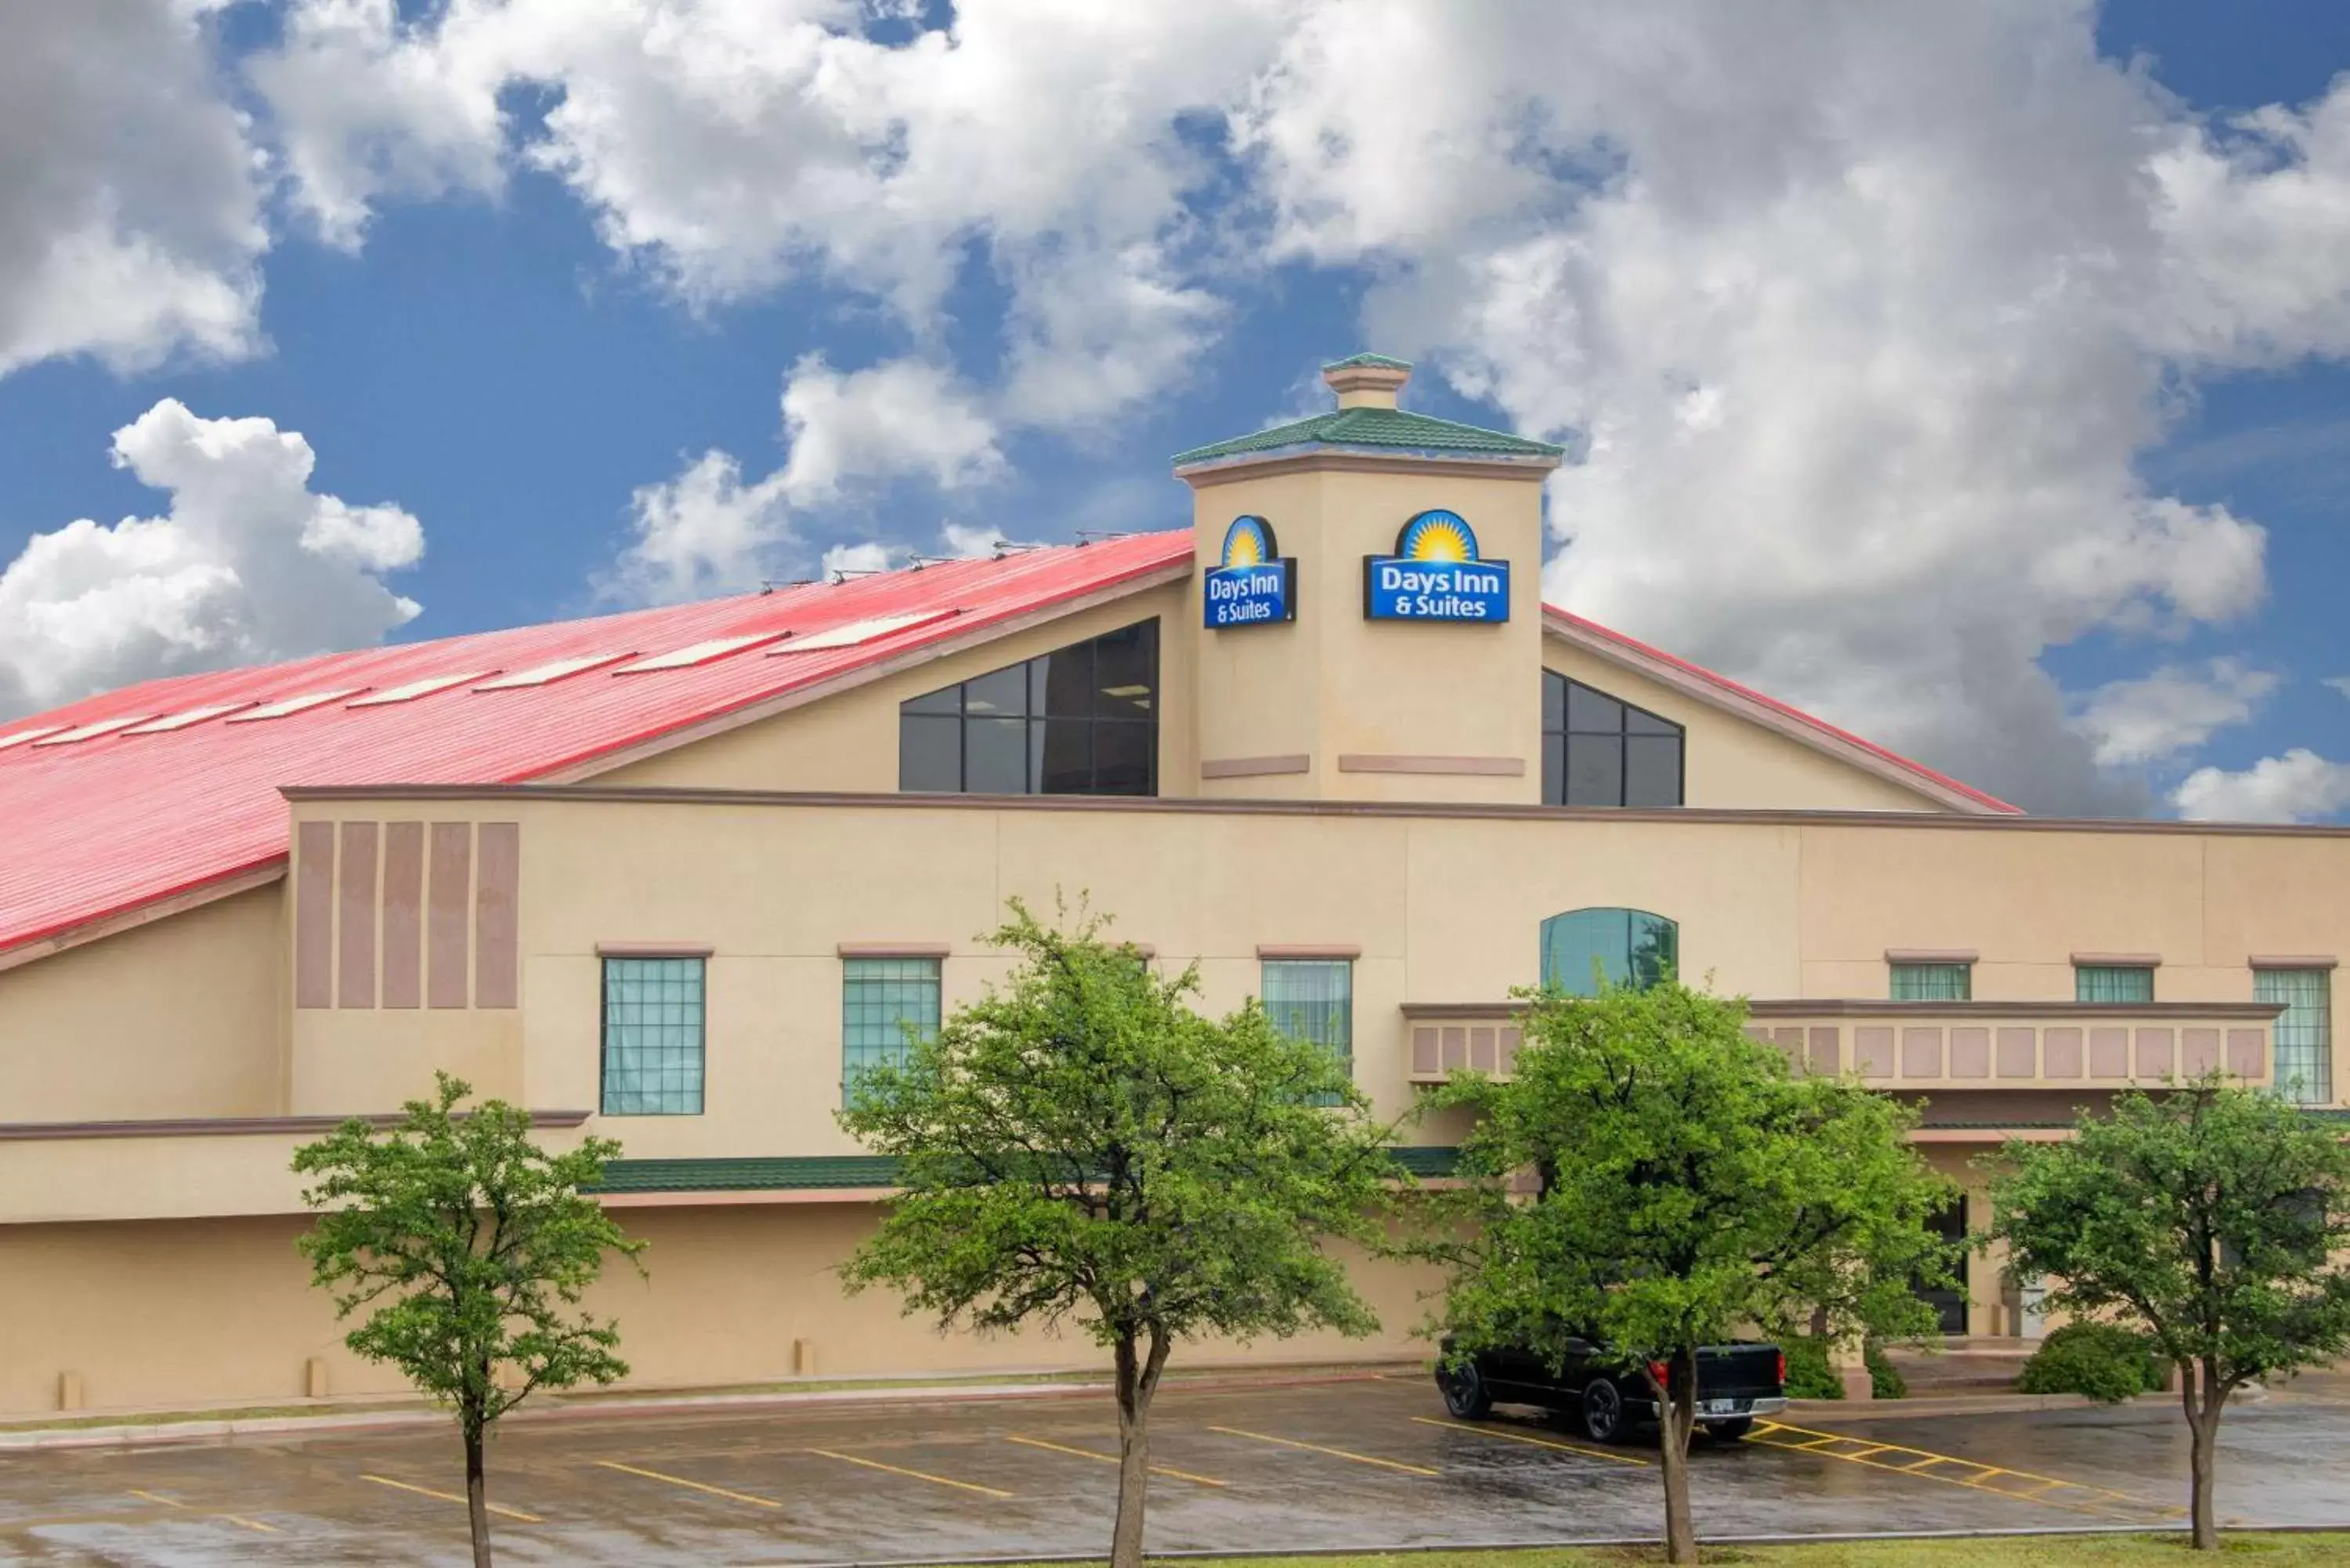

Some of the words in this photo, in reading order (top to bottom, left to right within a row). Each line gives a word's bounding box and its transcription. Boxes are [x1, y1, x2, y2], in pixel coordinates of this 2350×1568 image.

[1210, 578, 1249, 601] Days
[1251, 573, 1278, 595] Inn
[1382, 567, 1450, 594] Days
[1455, 569, 1499, 594] Inn
[1218, 605, 1227, 623] &
[1229, 599, 1271, 621] Suites
[1395, 596, 1412, 615] &
[1416, 595, 1487, 617] Suites
